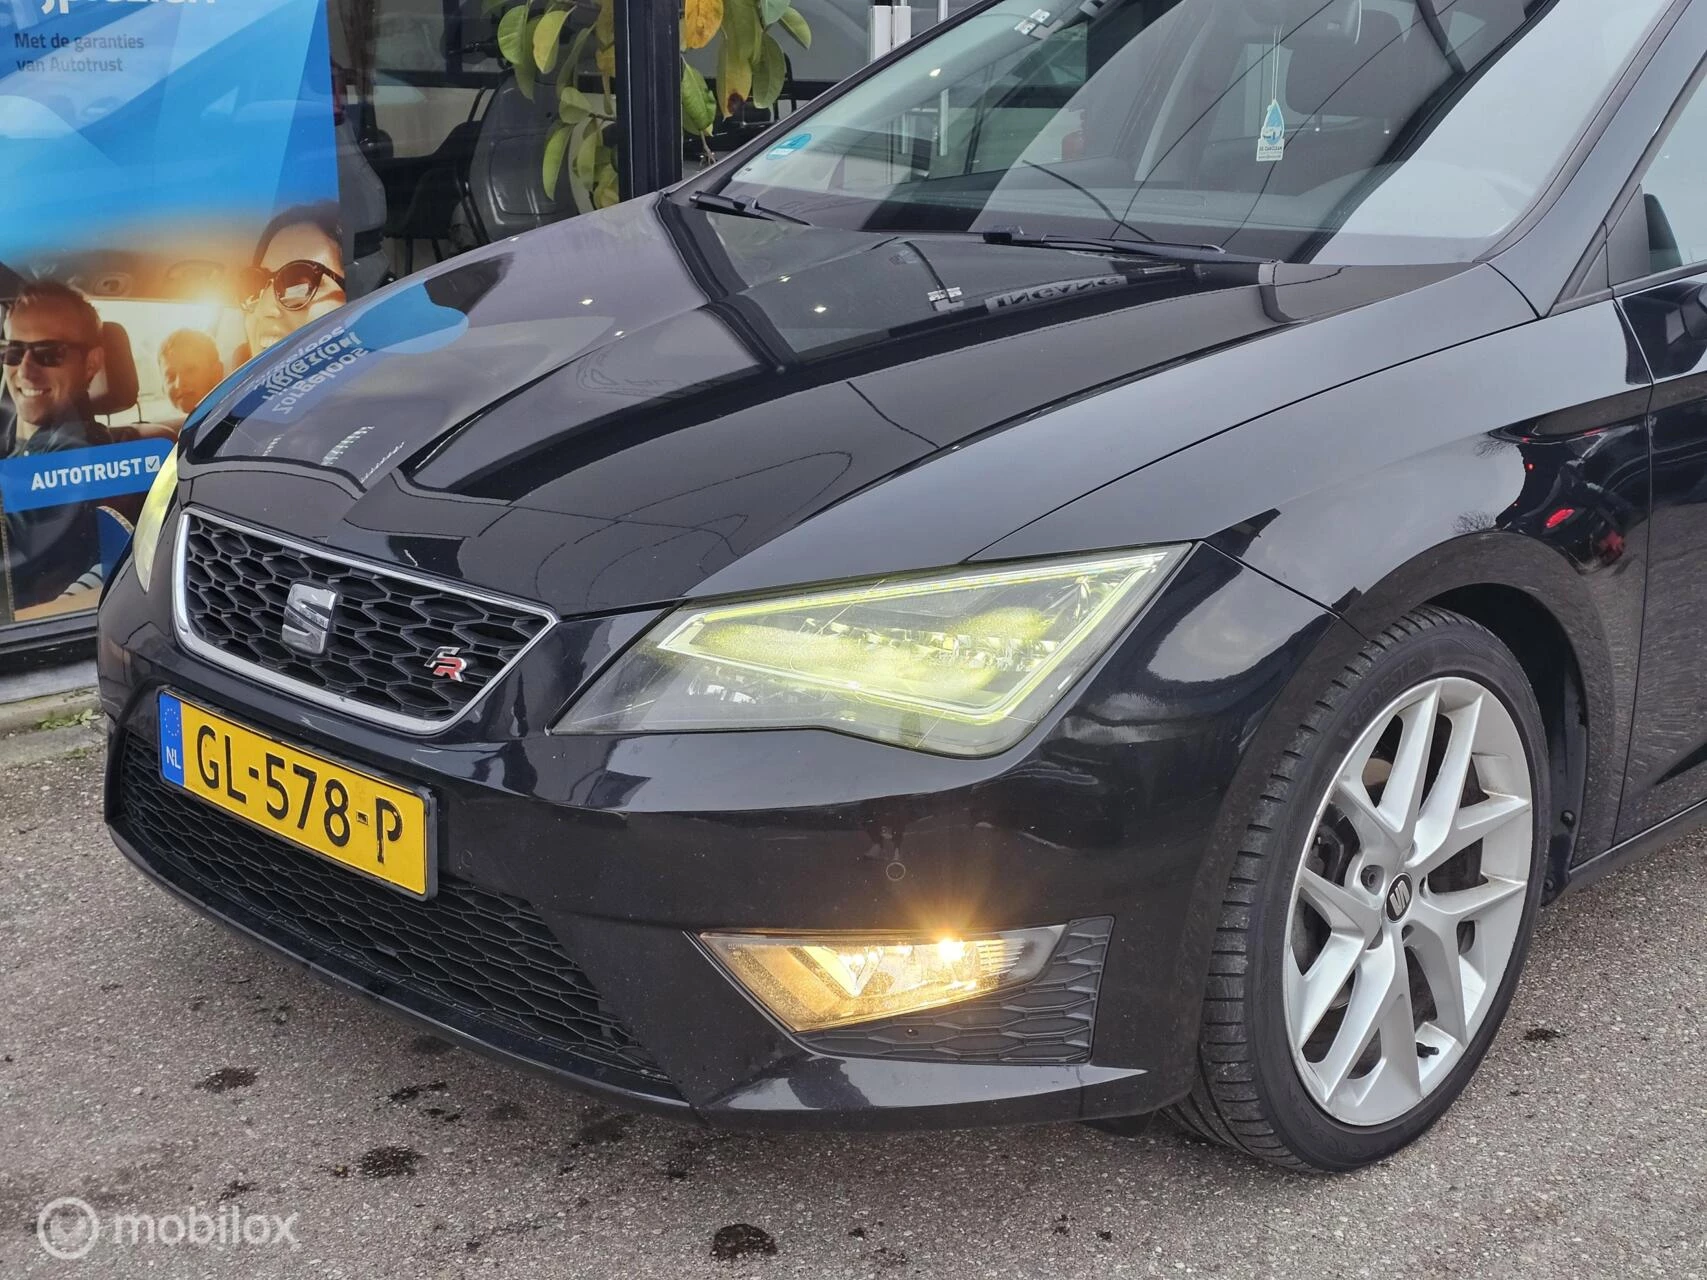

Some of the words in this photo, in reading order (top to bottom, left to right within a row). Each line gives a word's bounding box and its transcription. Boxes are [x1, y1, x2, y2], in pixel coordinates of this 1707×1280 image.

[14, 33, 46, 48] Met
[51, 33, 70, 48] de
[75, 33, 144, 52] garanties
[17, 60, 45, 72] van
[51, 57, 123, 73] Autotrust
[31, 457, 142, 491] AUTOTRUST
[166, 746, 181, 769] NL
[197, 724, 403, 865] GL-578-P
